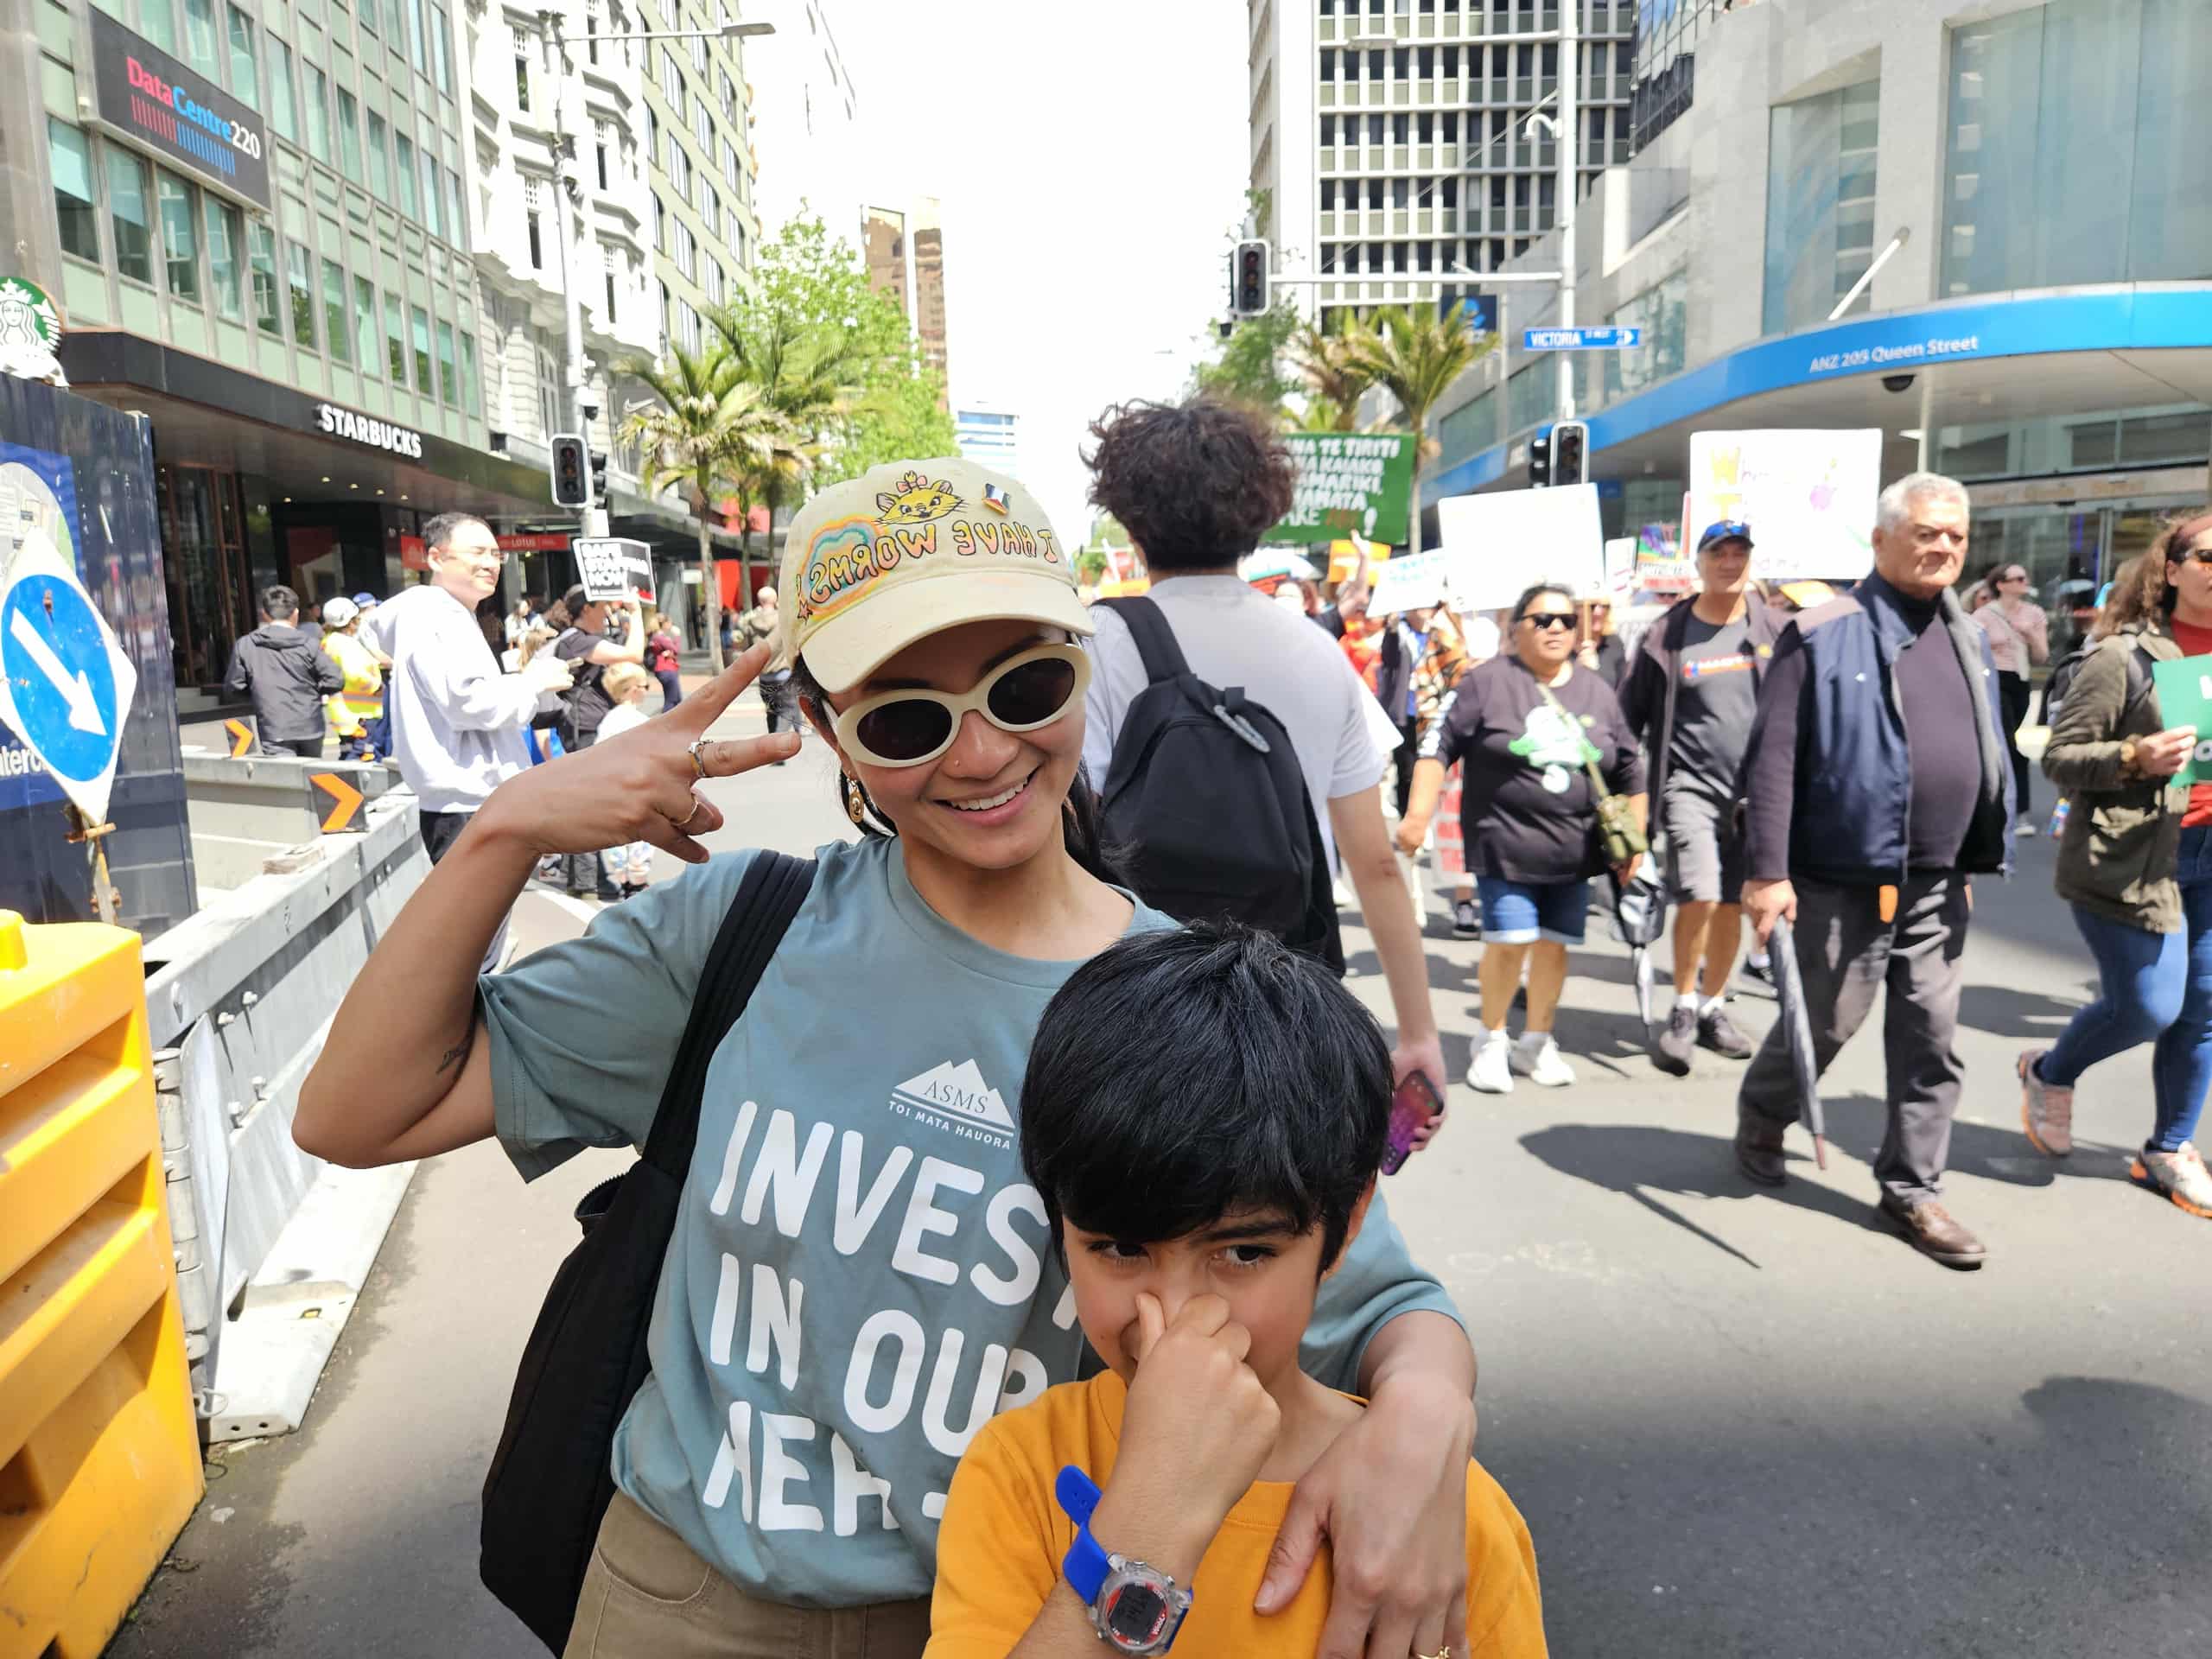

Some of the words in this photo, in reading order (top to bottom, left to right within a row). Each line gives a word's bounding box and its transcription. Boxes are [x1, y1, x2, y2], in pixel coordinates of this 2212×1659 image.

[127, 56, 260, 159] DataCentre220
[1530, 331, 1580, 346] VICTORIA
[1810, 353, 1840, 372] ANZ
[1872, 343, 1923, 362] Queen
[1927, 335, 1978, 355] Street
[321, 403, 422, 458] STARBUCKS
[1319, 438, 1343, 455] TE
[924, 1079, 988, 1113] ASMS
[889, 1100, 910, 1116] TOI
[915, 1111, 950, 1131] MATA
[955, 1124, 1010, 1149] HAUORA
[710, 1101, 1076, 1331] INVES
[710, 1252, 804, 1391] IN
